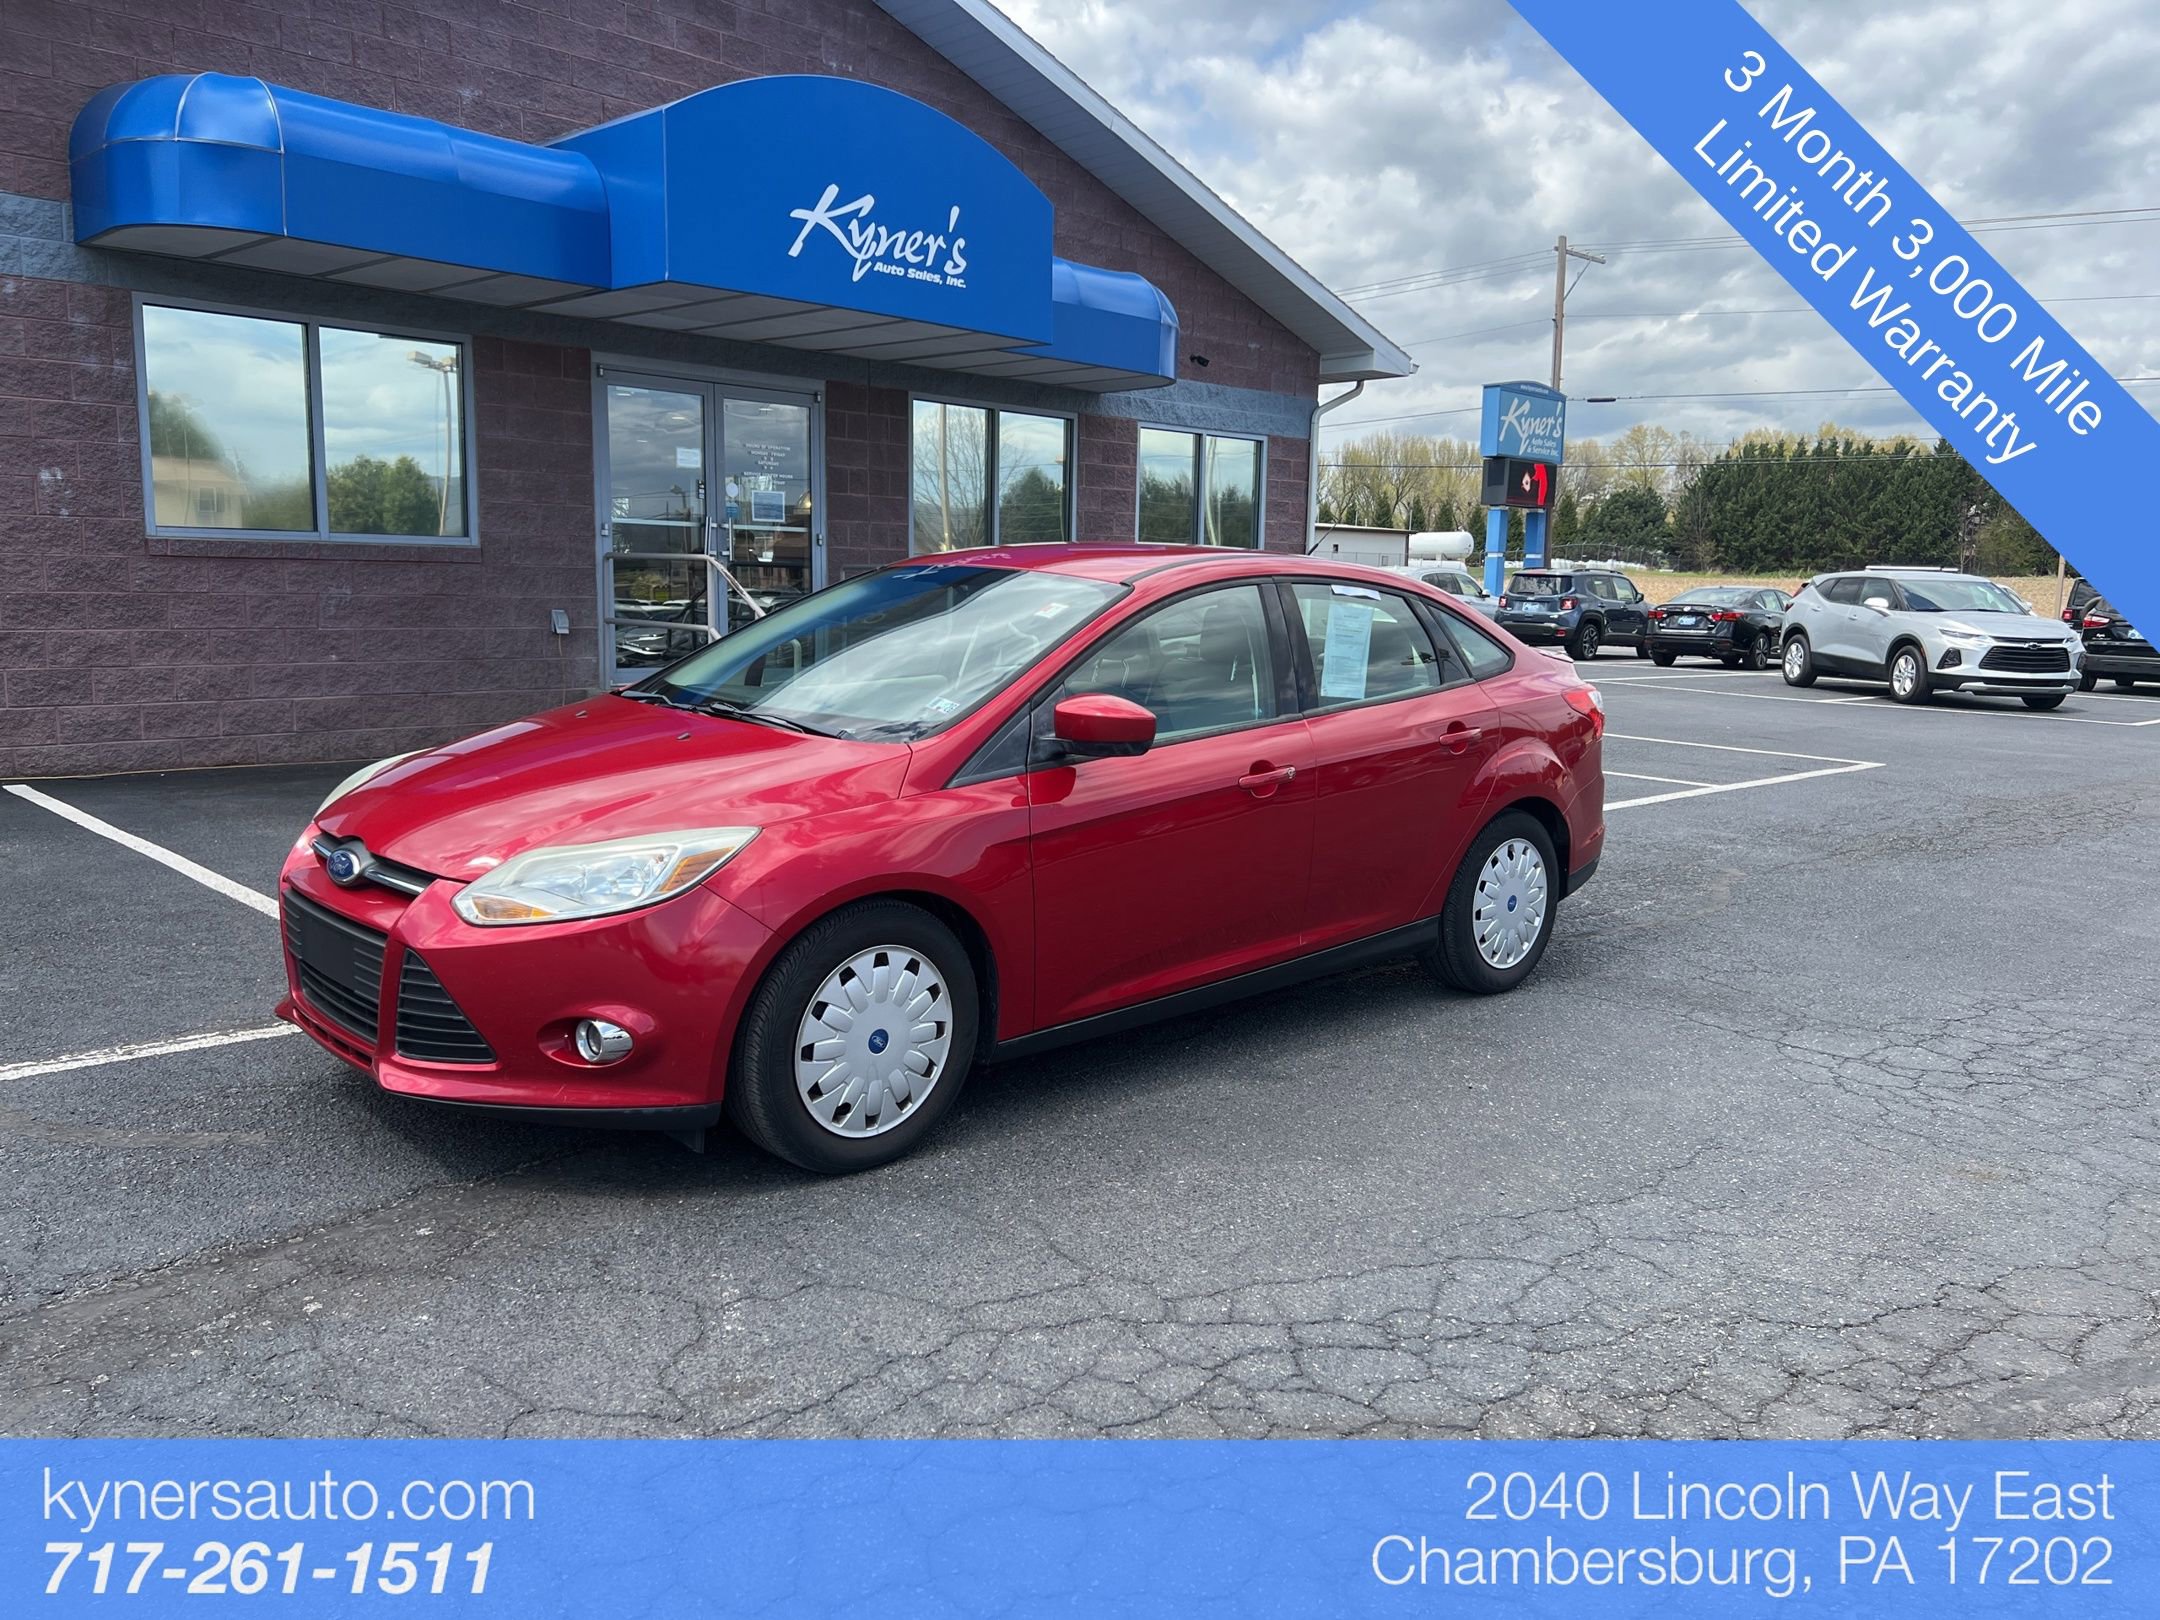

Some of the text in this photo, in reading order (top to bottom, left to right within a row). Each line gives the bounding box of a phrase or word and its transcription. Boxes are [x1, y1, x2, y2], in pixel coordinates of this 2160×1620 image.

[788, 184, 967, 282] Kyner's
[873, 261, 967, 288] Auto Sales, Inc.
[1499, 397, 1562, 456] Kyner's
